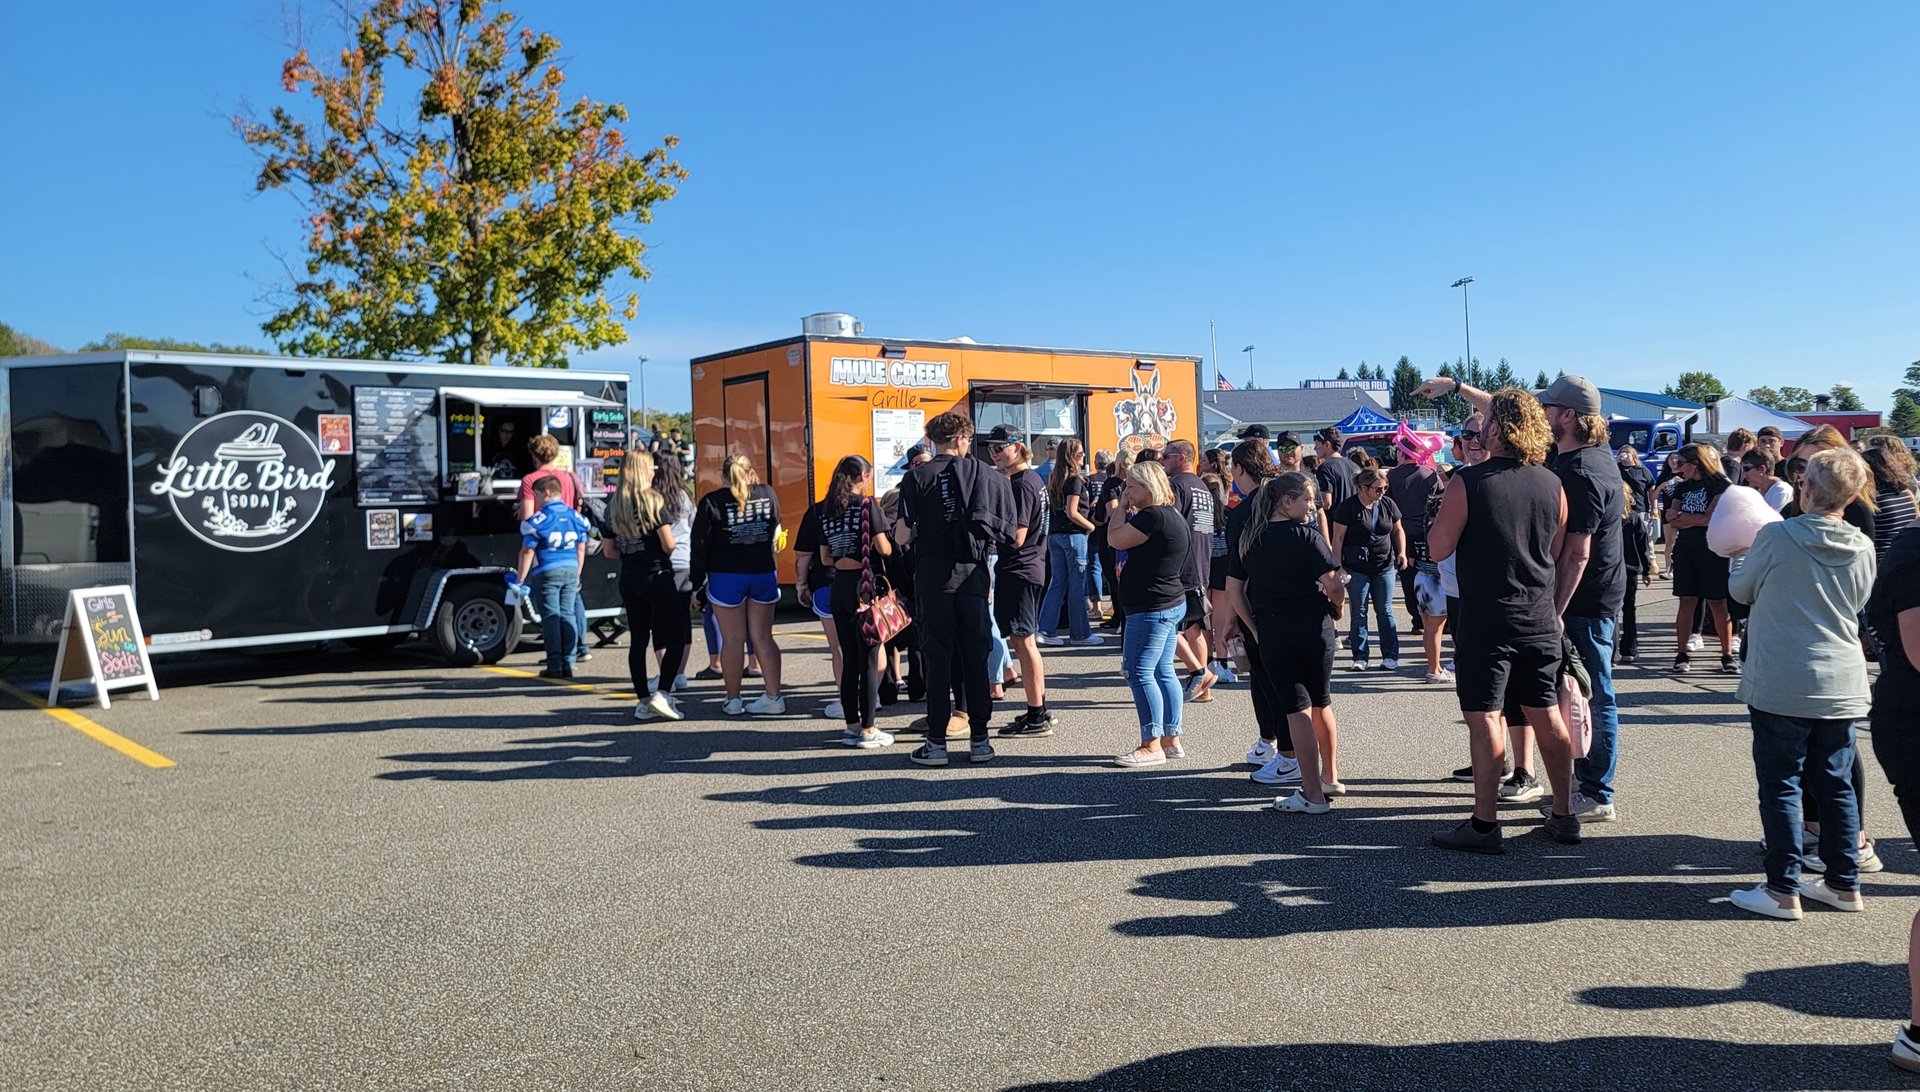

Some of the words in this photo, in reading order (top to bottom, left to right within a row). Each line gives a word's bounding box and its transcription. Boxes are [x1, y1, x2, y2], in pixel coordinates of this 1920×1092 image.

[830, 357, 888, 386] MULE
[889, 361, 951, 388] CREEK
[1371, 381, 1388, 390] FIELD
[872, 389, 918, 408] Grille
[150, 456, 251, 498] Little
[256, 459, 337, 491] Bird
[230, 494, 270, 508] SODA
[94, 621, 132, 644] Sun
[101, 651, 140, 674] Soda
